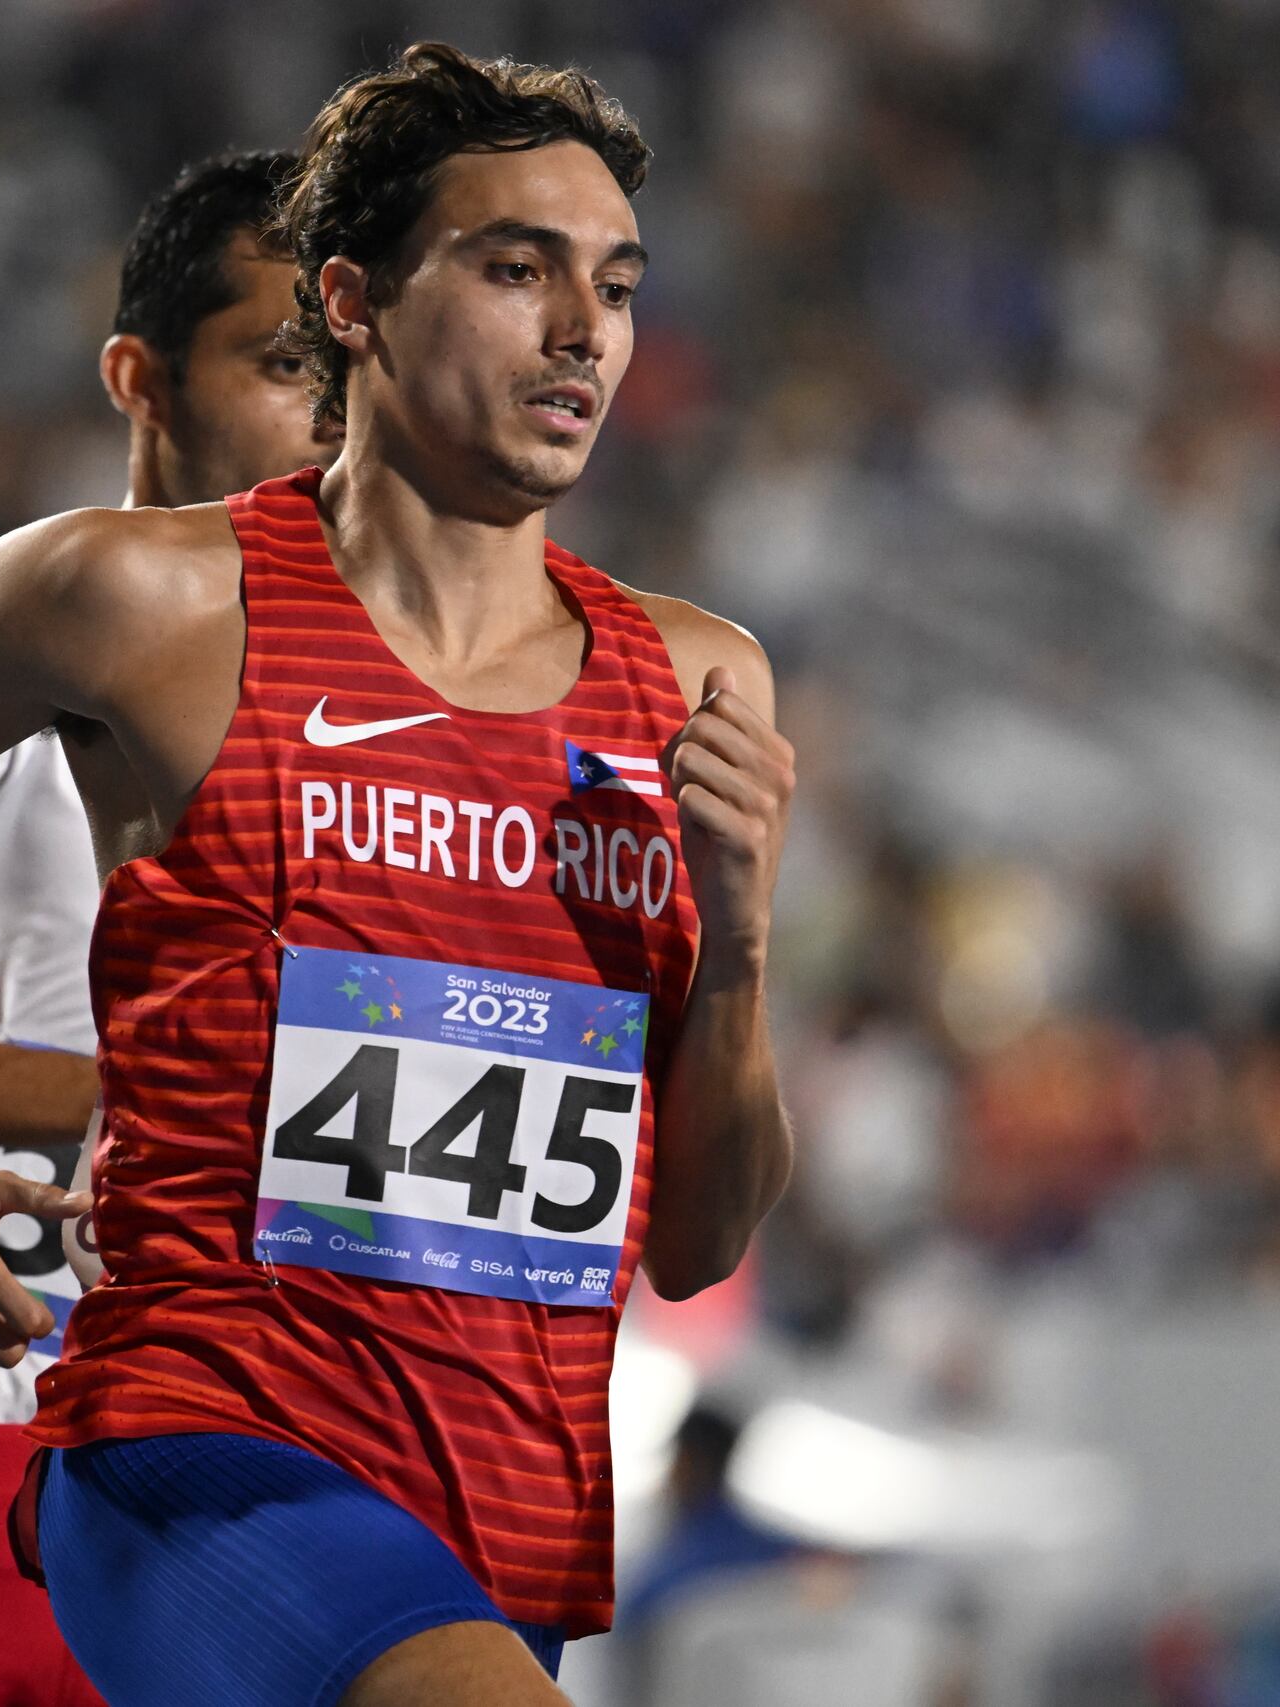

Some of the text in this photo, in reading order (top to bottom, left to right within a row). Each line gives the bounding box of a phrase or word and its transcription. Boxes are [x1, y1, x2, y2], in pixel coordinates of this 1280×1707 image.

[301, 781, 675, 920] PUERTO RICO
[446, 974, 552, 1002] San Salvador
[442, 989, 550, 1035] 2023
[272, 1044, 637, 1234] 445
[257, 1230, 314, 1246] Electrolit
[348, 1242, 411, 1260] CUSCATLAN
[470, 1259, 515, 1278] SISA
[580, 1278, 608, 1291] NAN
